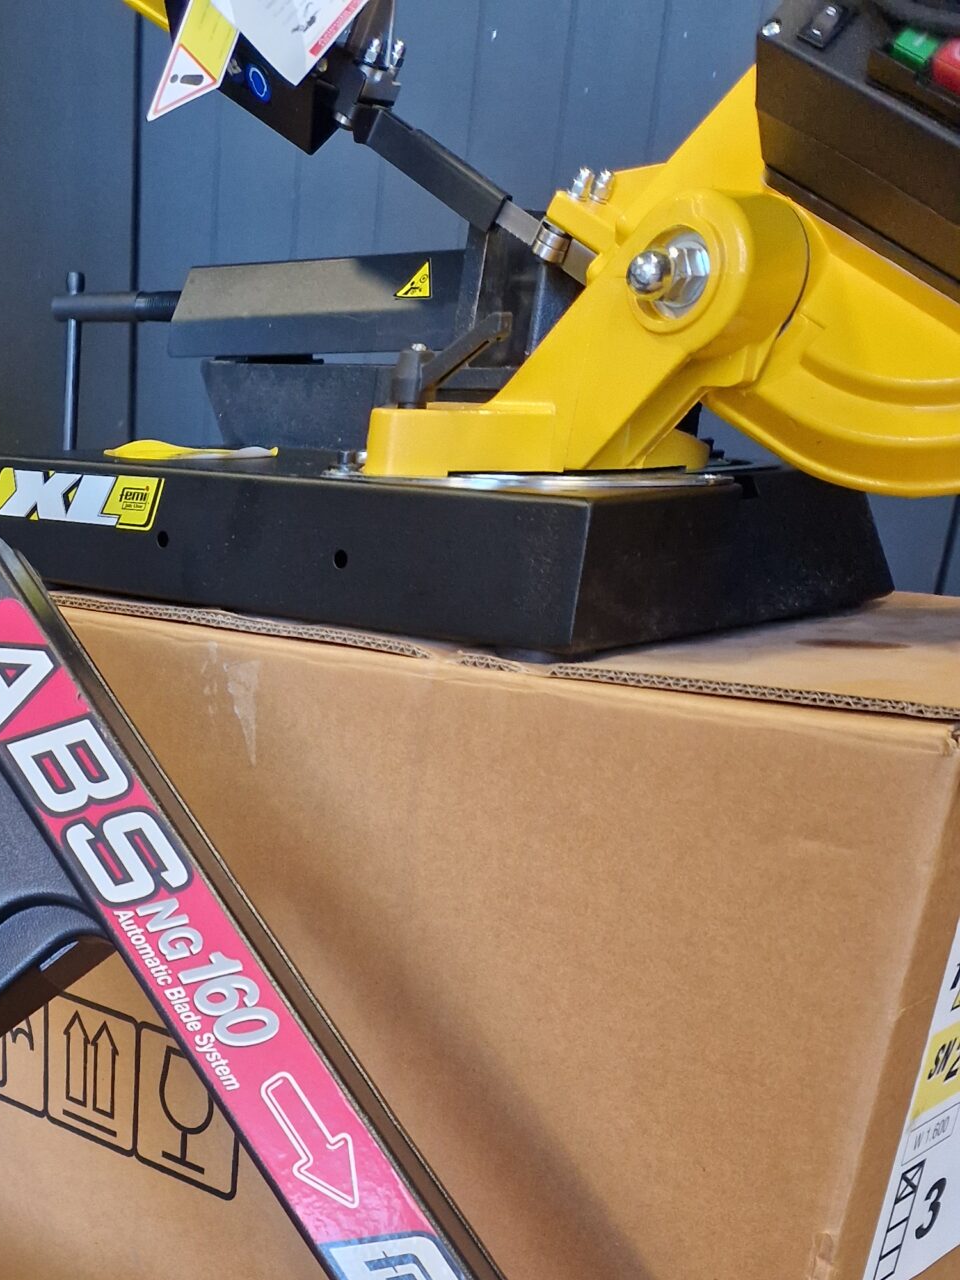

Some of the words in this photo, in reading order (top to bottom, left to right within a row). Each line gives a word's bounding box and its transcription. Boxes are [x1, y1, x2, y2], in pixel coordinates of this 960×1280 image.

[113, 909, 173, 986] Automatic
[164, 986, 202, 1032] Blade
[194, 1032, 241, 1092] System
[914, 1176, 947, 1240] 3
